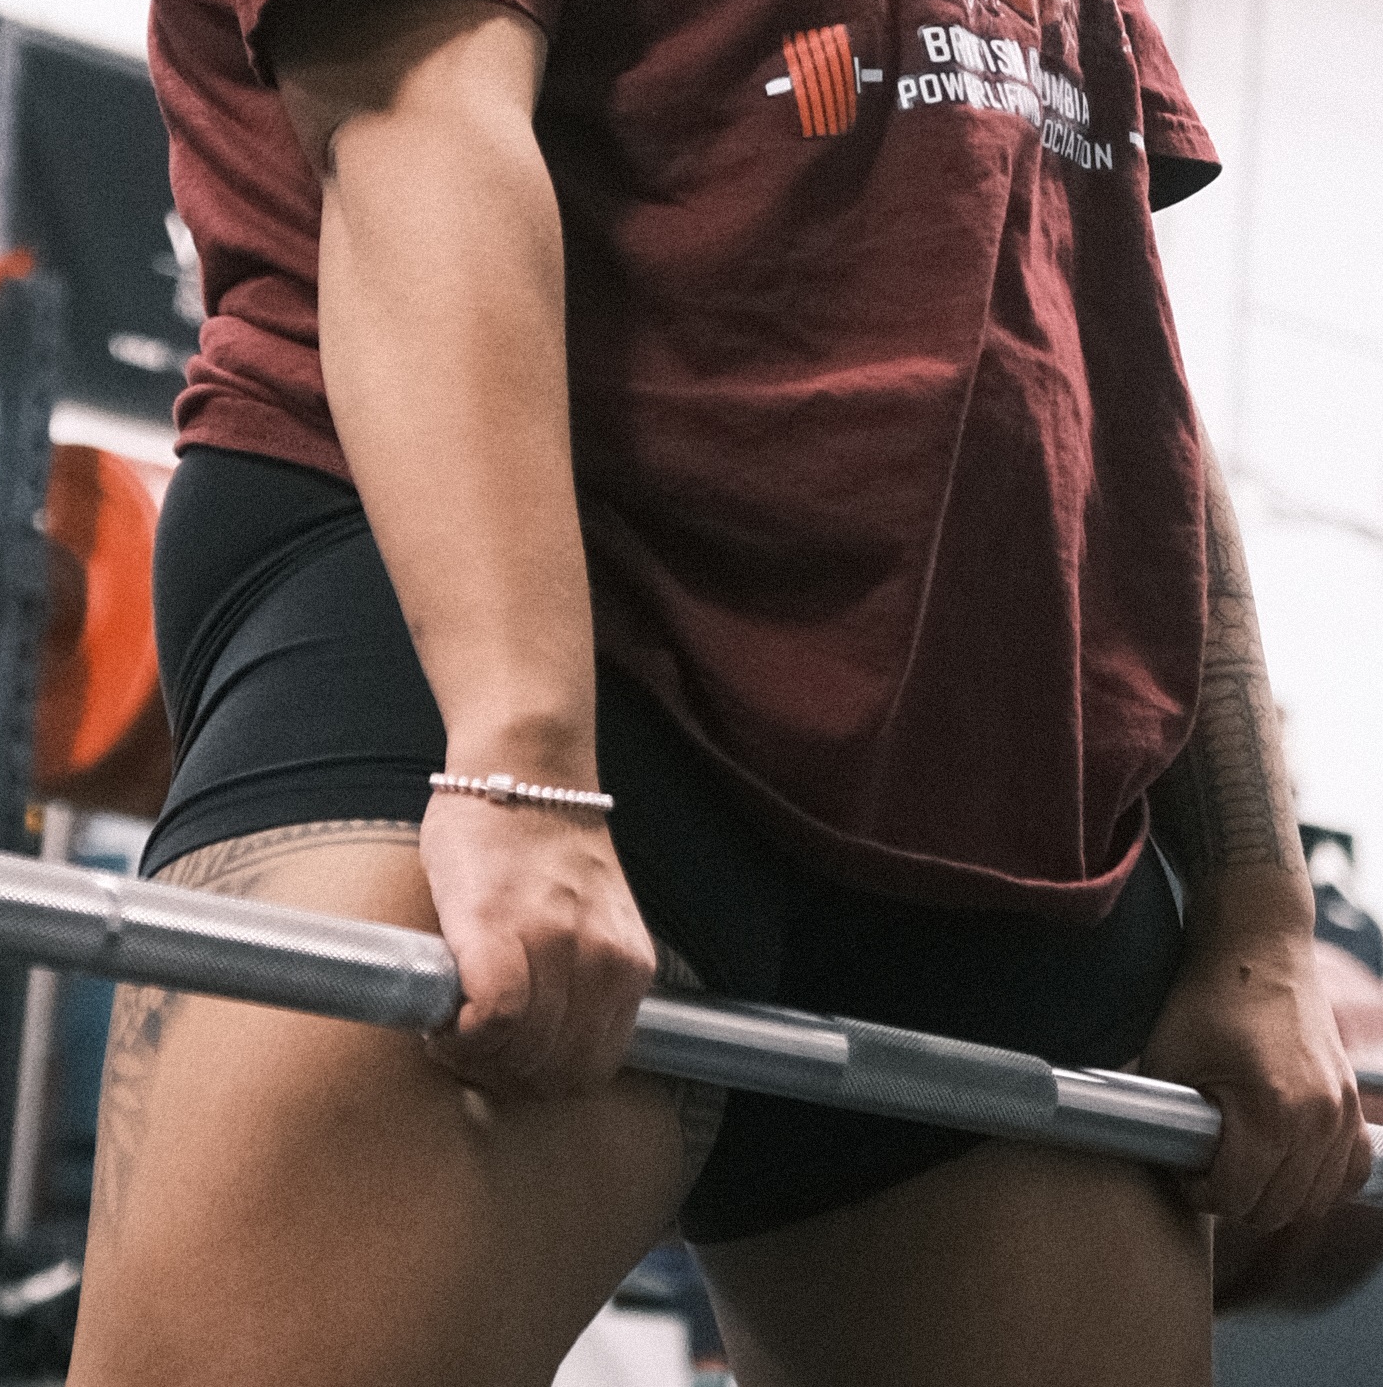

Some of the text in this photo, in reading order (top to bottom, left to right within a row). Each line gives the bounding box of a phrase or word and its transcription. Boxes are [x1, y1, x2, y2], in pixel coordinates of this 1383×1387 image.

[897, 70, 1042, 127] POWRLIF
[1029, 47, 1091, 125] UMBIA
[1041, 117, 1113, 170] OCIATON
